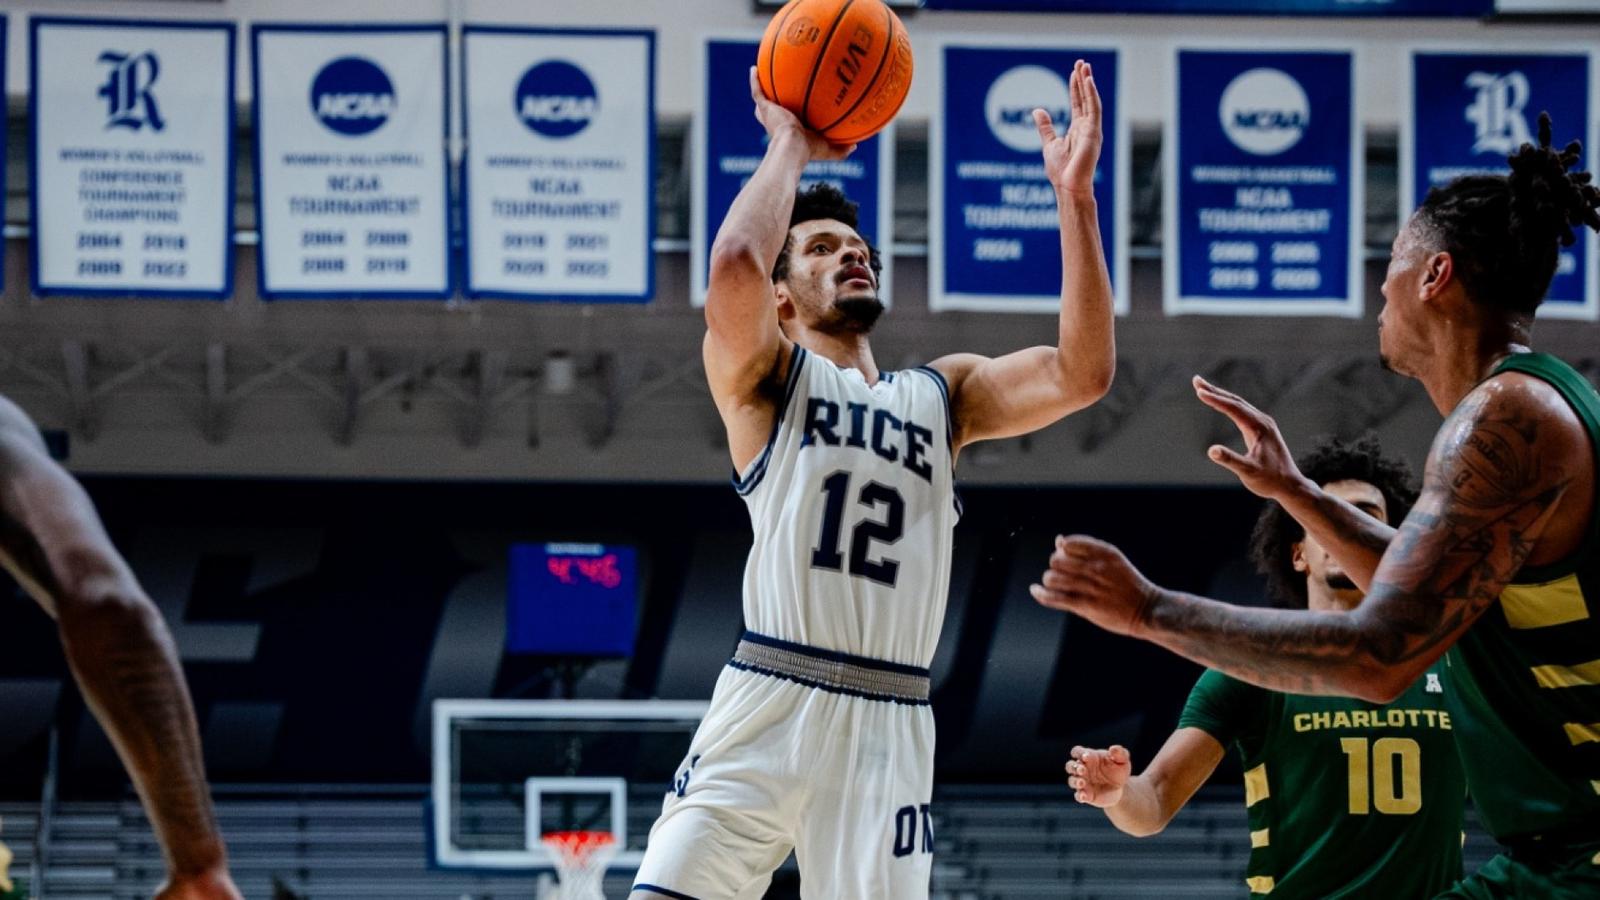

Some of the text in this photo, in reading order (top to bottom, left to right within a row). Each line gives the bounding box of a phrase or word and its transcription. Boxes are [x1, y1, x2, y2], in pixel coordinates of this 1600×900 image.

[318, 92, 396, 118] NCAA
[521, 95, 598, 120] NCAA
[1001, 108, 1068, 130] NCA
[1233, 109, 1308, 131] NCAA
[79, 168, 183, 185] CONFERENCE
[326, 174, 382, 192] NCAA
[528, 177, 583, 196] NCAA
[78, 186, 186, 204] TOURNAMENT
[288, 196, 420, 216] TOURNAMENT
[83, 205, 180, 223] CHAMPIONS
[491, 199, 621, 219] TOURNAMENT
[800, 397, 934, 485] RICE
[810, 468, 906, 589] 12
[1293, 709, 1452, 732] CHARLOTTE
[1340, 737, 1422, 815] 10
